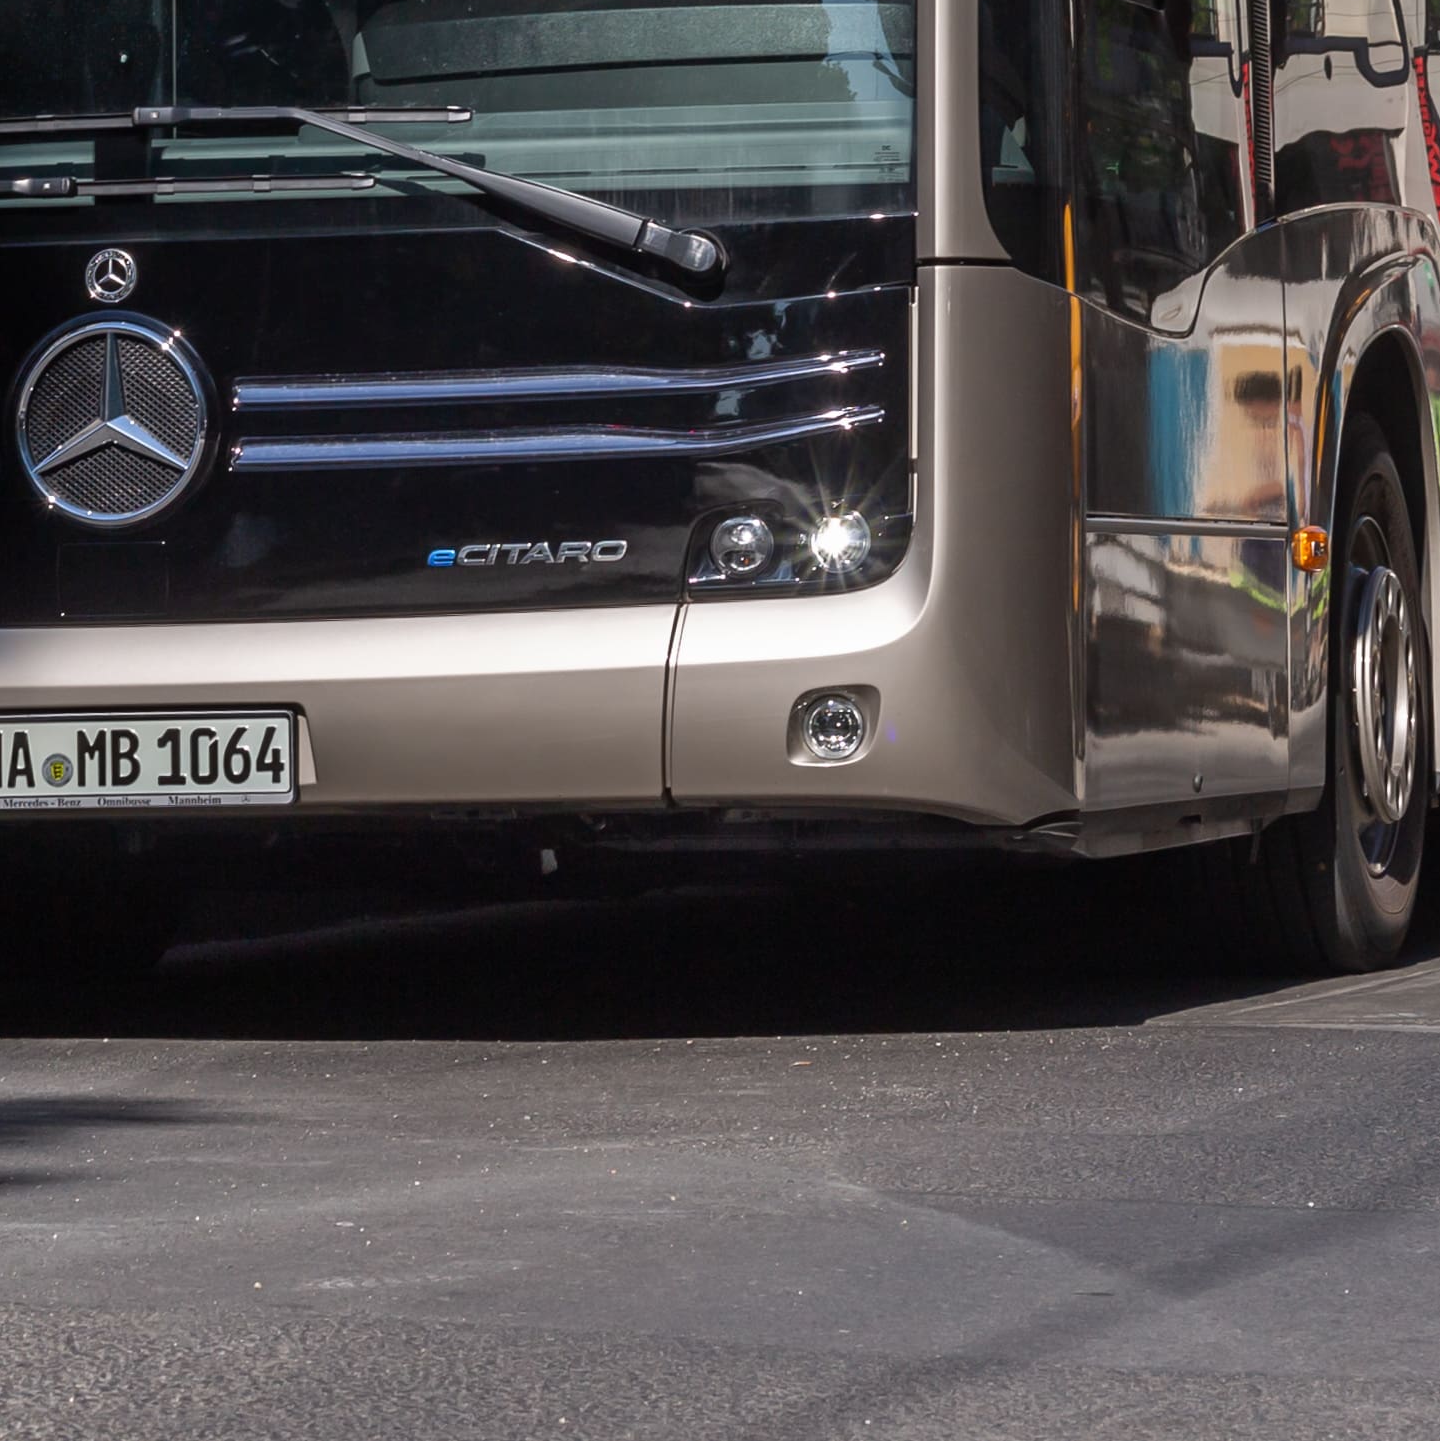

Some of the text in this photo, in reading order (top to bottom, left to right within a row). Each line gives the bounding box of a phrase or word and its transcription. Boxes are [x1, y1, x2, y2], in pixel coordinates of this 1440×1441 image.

[427, 539, 628, 568] eCITARO
[77, 728, 142, 787] MB
[157, 725, 286, 787] 1064
[97, 795, 152, 808] Omnibusse
[168, 794, 222, 806] Mannheim
